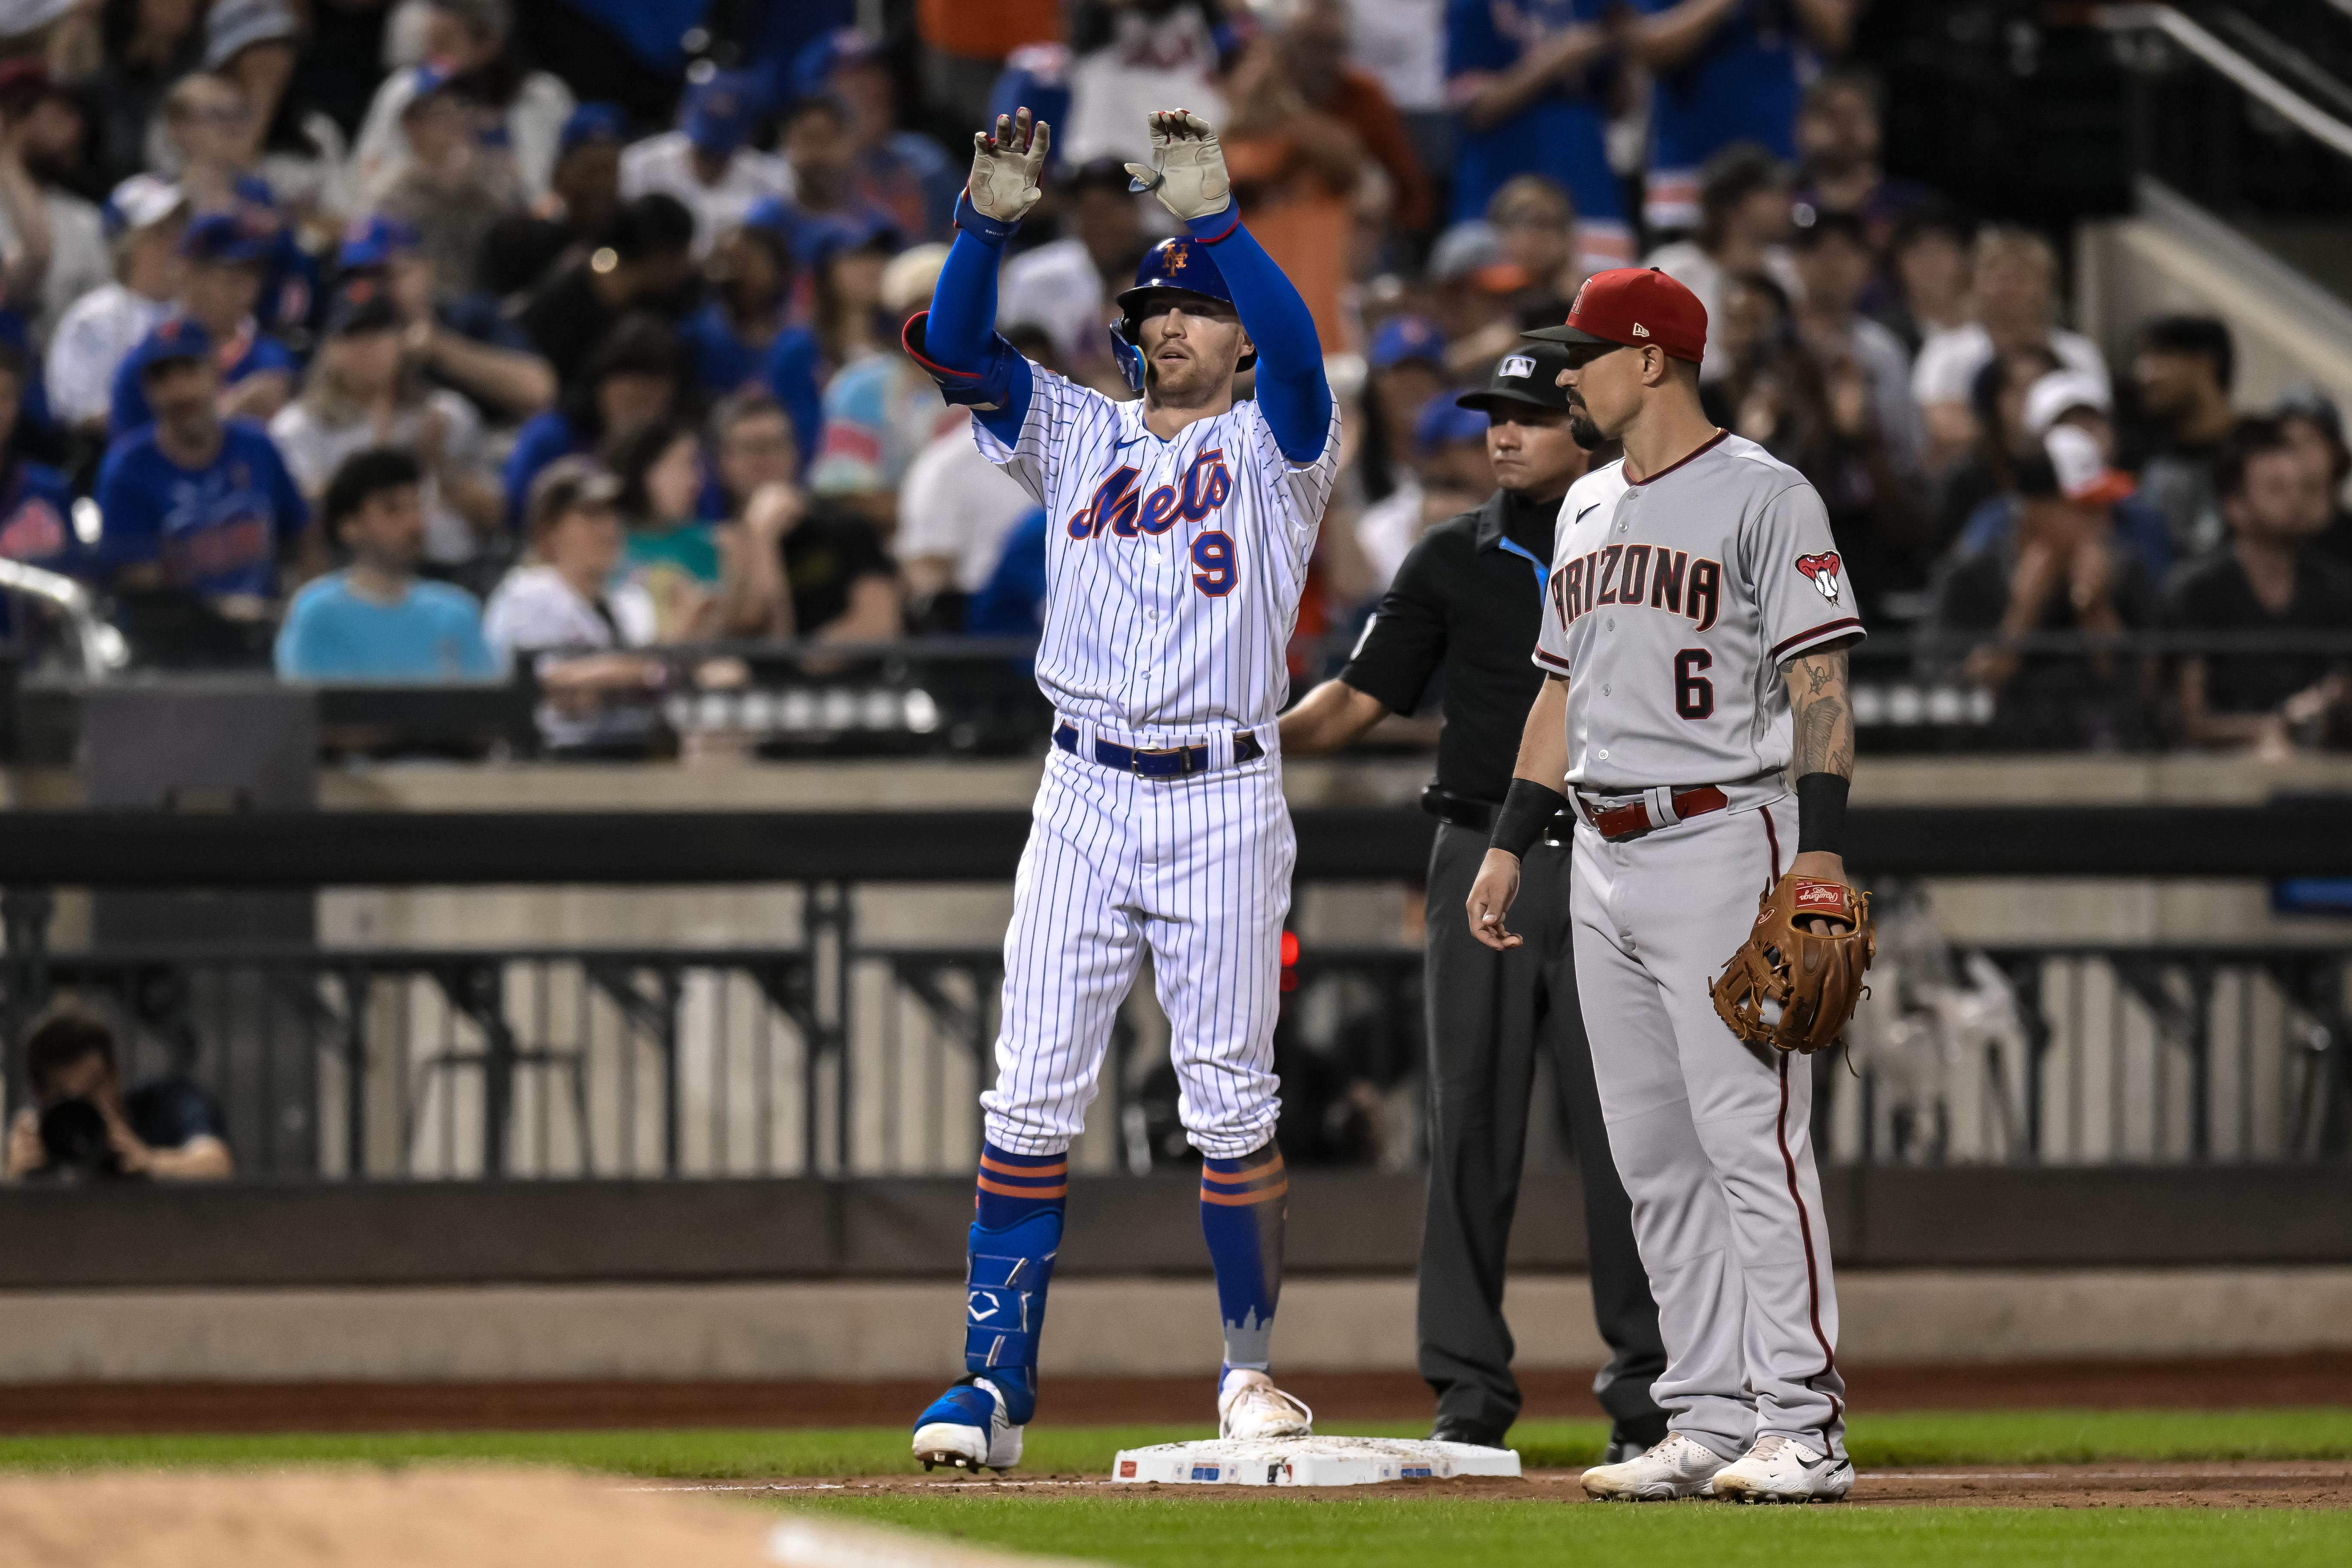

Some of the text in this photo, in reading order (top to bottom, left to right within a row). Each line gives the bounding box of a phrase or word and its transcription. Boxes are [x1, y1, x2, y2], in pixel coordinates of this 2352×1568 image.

[1067, 447, 1232, 540] Mets
[1190, 530, 1238, 597] 9
[1550, 543, 1722, 633] ARIZONA
[1674, 648, 1714, 720] 6
[1799, 889, 1838, 902] Rawlings
